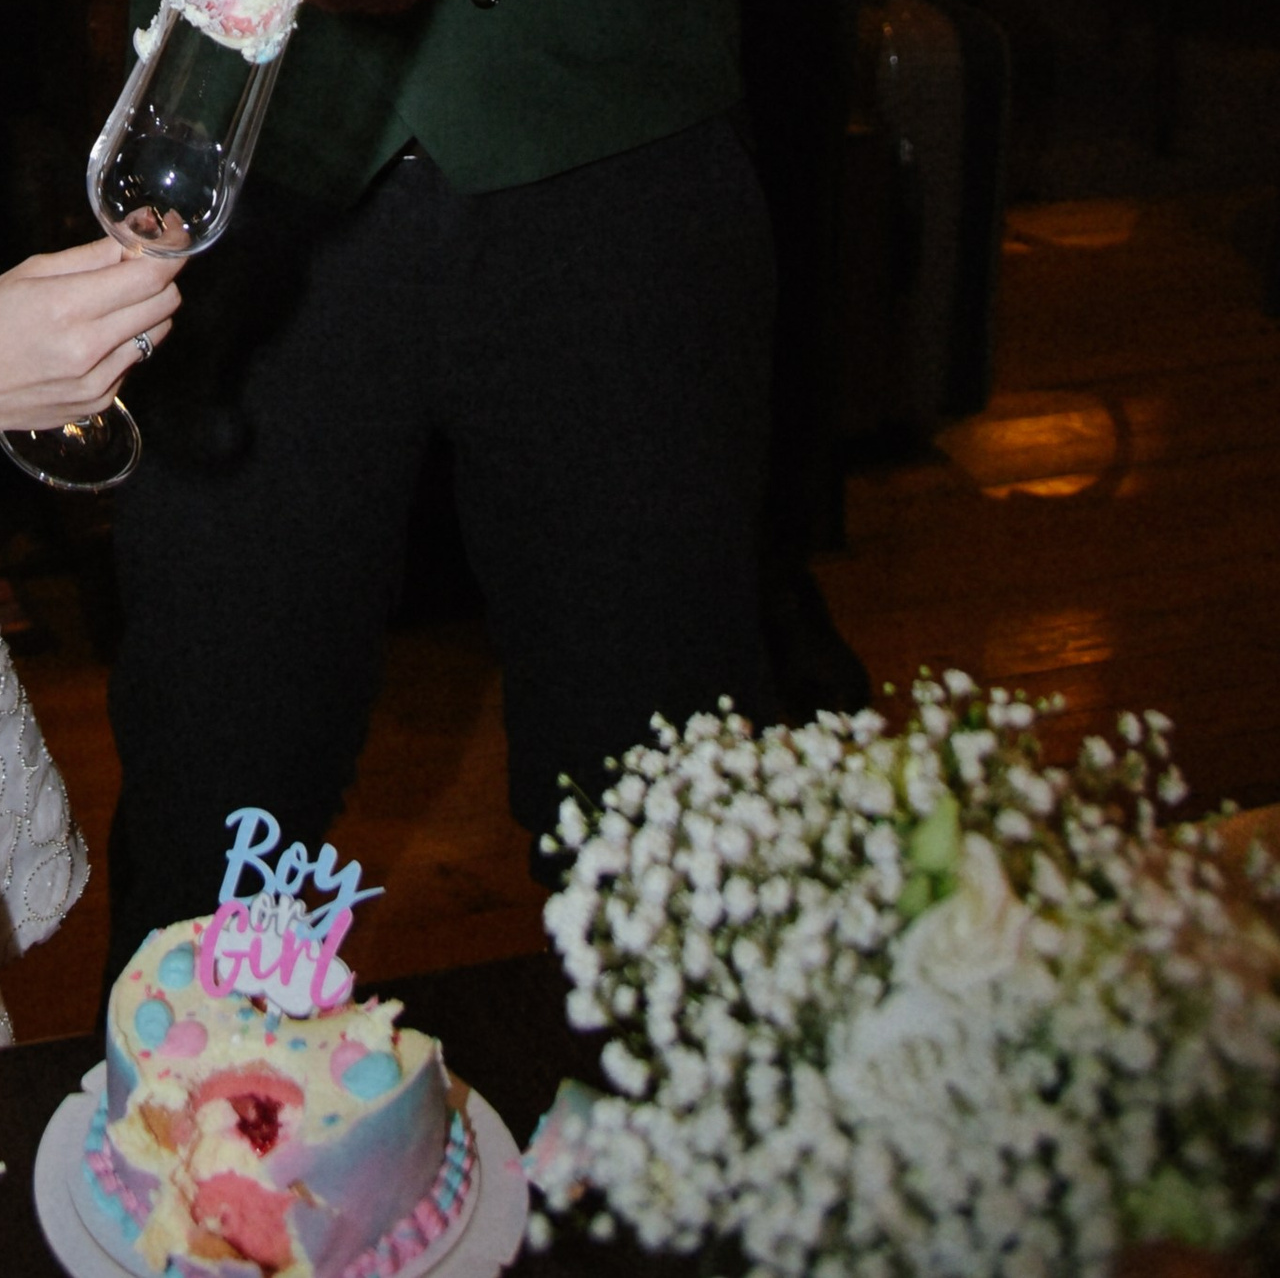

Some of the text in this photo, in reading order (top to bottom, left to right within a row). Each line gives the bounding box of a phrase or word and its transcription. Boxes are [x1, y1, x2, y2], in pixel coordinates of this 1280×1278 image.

[218, 806, 386, 941] Boy
[249, 890, 313, 937] or
[199, 899, 357, 1009] Girl
